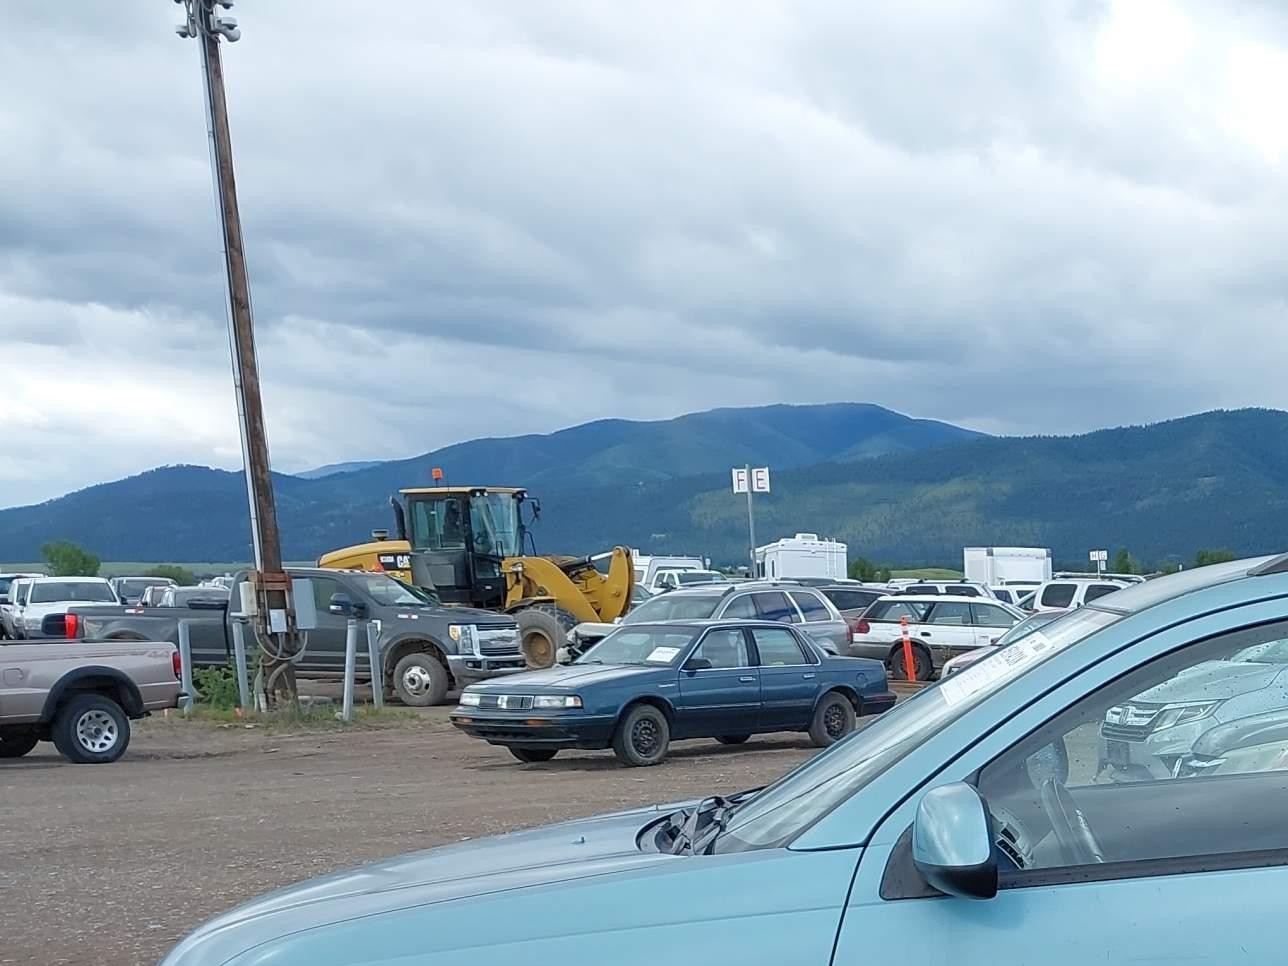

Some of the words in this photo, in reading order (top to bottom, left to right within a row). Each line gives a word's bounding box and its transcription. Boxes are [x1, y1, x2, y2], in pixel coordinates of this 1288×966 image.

[737, 470, 745, 491] F
[755, 470, 766, 490] E
[396, 555, 411, 569] CA
